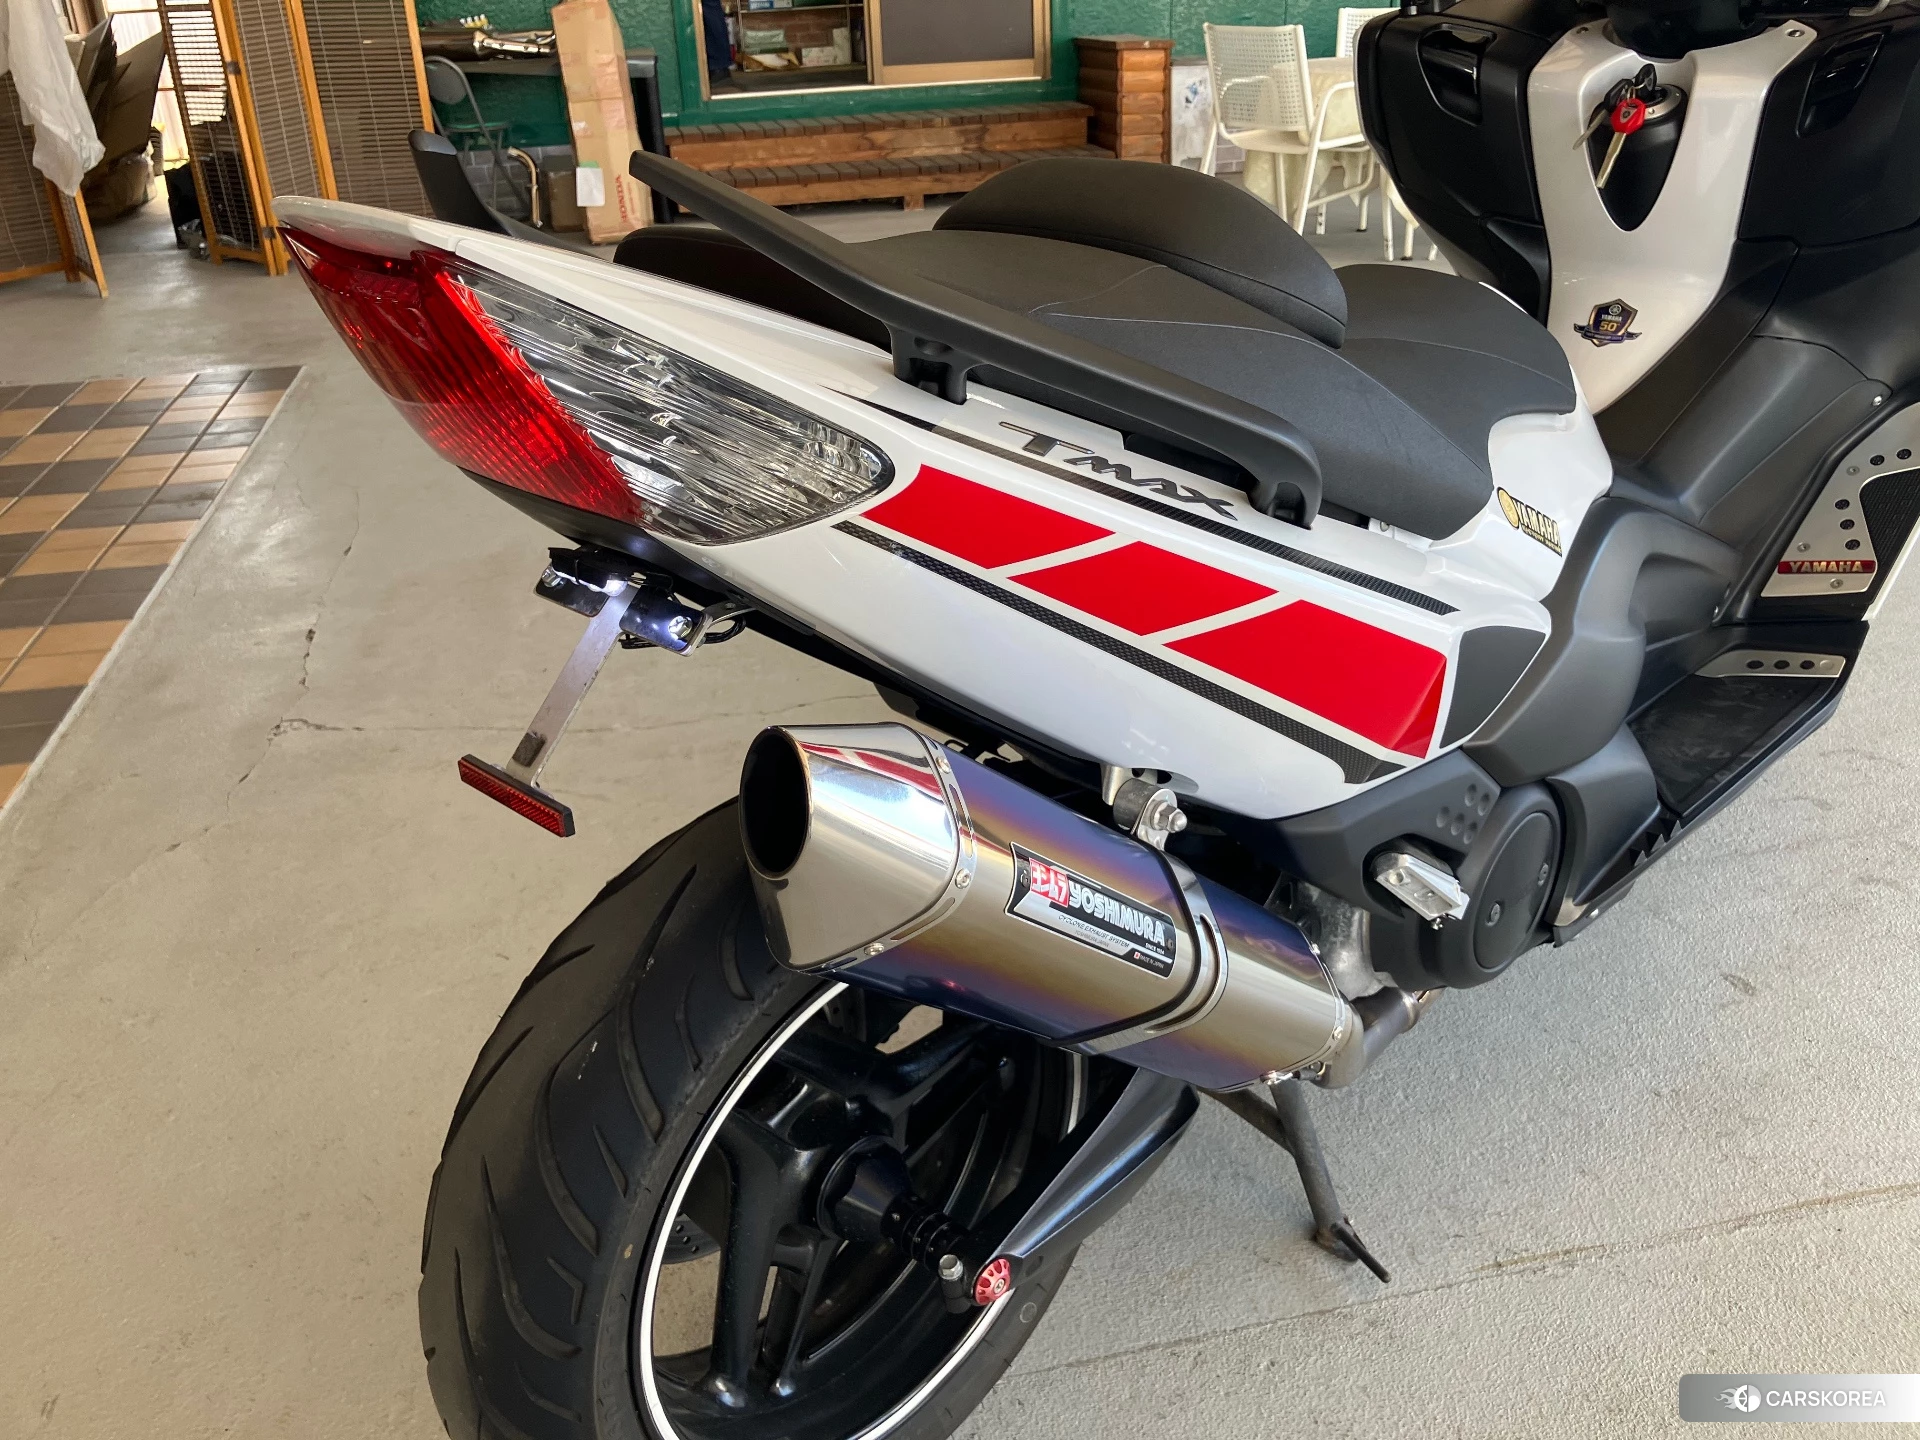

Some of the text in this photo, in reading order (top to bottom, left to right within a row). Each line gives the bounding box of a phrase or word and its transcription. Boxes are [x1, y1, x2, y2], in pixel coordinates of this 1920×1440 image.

[998, 421, 1238, 521] TMAX
[1511, 497, 1562, 549] YAMAHA
[1789, 561, 1864, 573] YAMAHA
[1058, 914, 1130, 948] CYCLONE EXHAUST SYSTEM
[1068, 879, 1166, 947] YOSHIMURA
